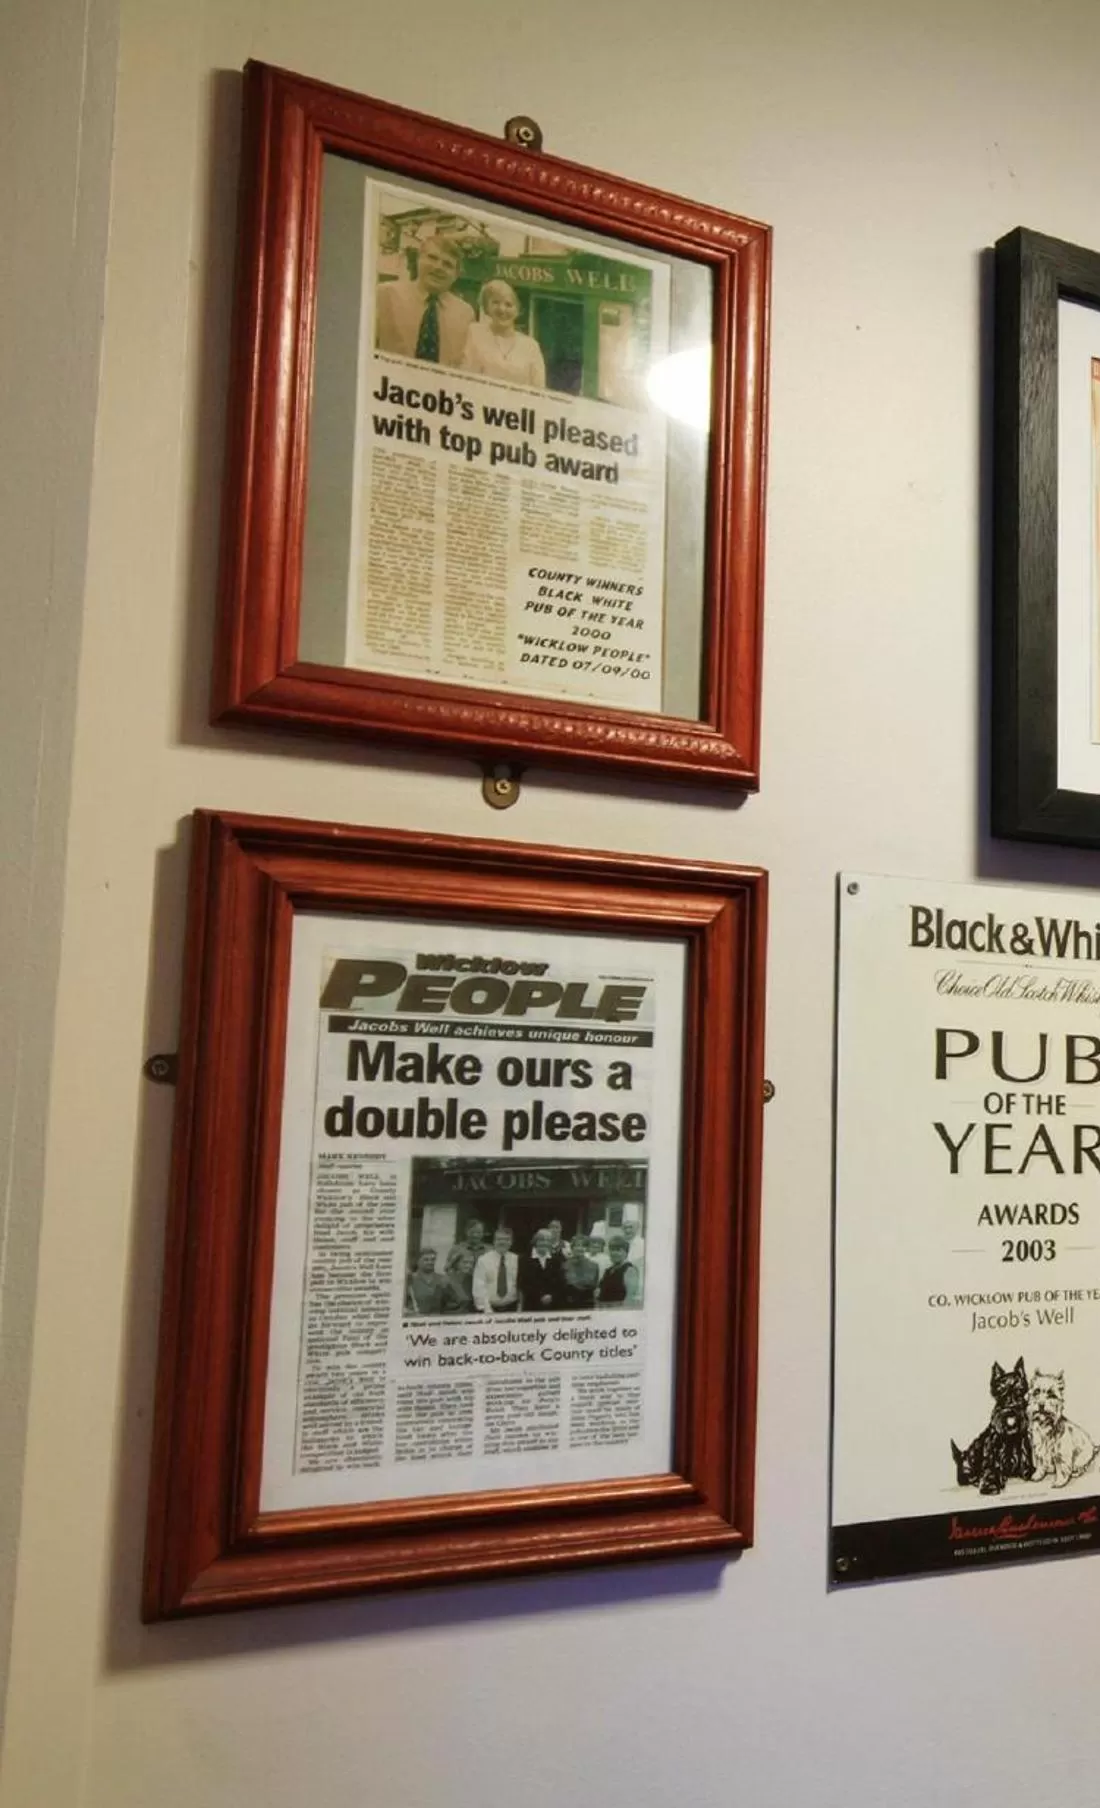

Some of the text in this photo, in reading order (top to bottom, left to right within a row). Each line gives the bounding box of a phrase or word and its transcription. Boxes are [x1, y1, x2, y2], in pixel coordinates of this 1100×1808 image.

[495, 263, 555, 283] JACOBS
[373, 375, 474, 421] Jacob's
[482, 404, 535, 435] well
[543, 419, 638, 457] pleased
[372, 412, 620, 484] with top pub award
[528, 567, 644, 597] COUNTY WINNERS
[538, 586, 634, 611] BLACK WHITE
[524, 601, 644, 630] PUB OF THE YEAR
[571, 625, 612, 641] 2000
[520, 653, 651, 680] DATED 07/09/00
[415, 953, 549, 977] Wicklow
[319, 958, 648, 1023] PEOPLE
[348, 1020, 640, 1044] Jacobs Well achieves unique honour
[347, 1040, 632, 1091] Make ours a
[983, 1092, 1066, 1116] OF THE
[324, 1095, 647, 1151] double please
[452, 1171, 552, 1191] JACOBS
[977, 1202, 1080, 1227] AWARDS
[1001, 1240, 1057, 1262] 2003
[928, 1294, 951, 1308] CO.
[954, 1292, 1014, 1306] WICKLOW
[1017, 1291, 1040, 1304] PUB
[1044, 1290, 1060, 1302] OF
[1063, 1289, 1084, 1301] THE
[972, 1308, 1075, 1332] Jacob's Well
[444, 1334, 467, 1346] are
[472, 1329, 547, 1348] absolutely
[552, 1326, 617, 1345] delighted
[622, 1326, 637, 1339] to
[404, 1355, 431, 1367] win
[437, 1348, 535, 1367] back-to-back
[540, 1346, 594, 1365] County
